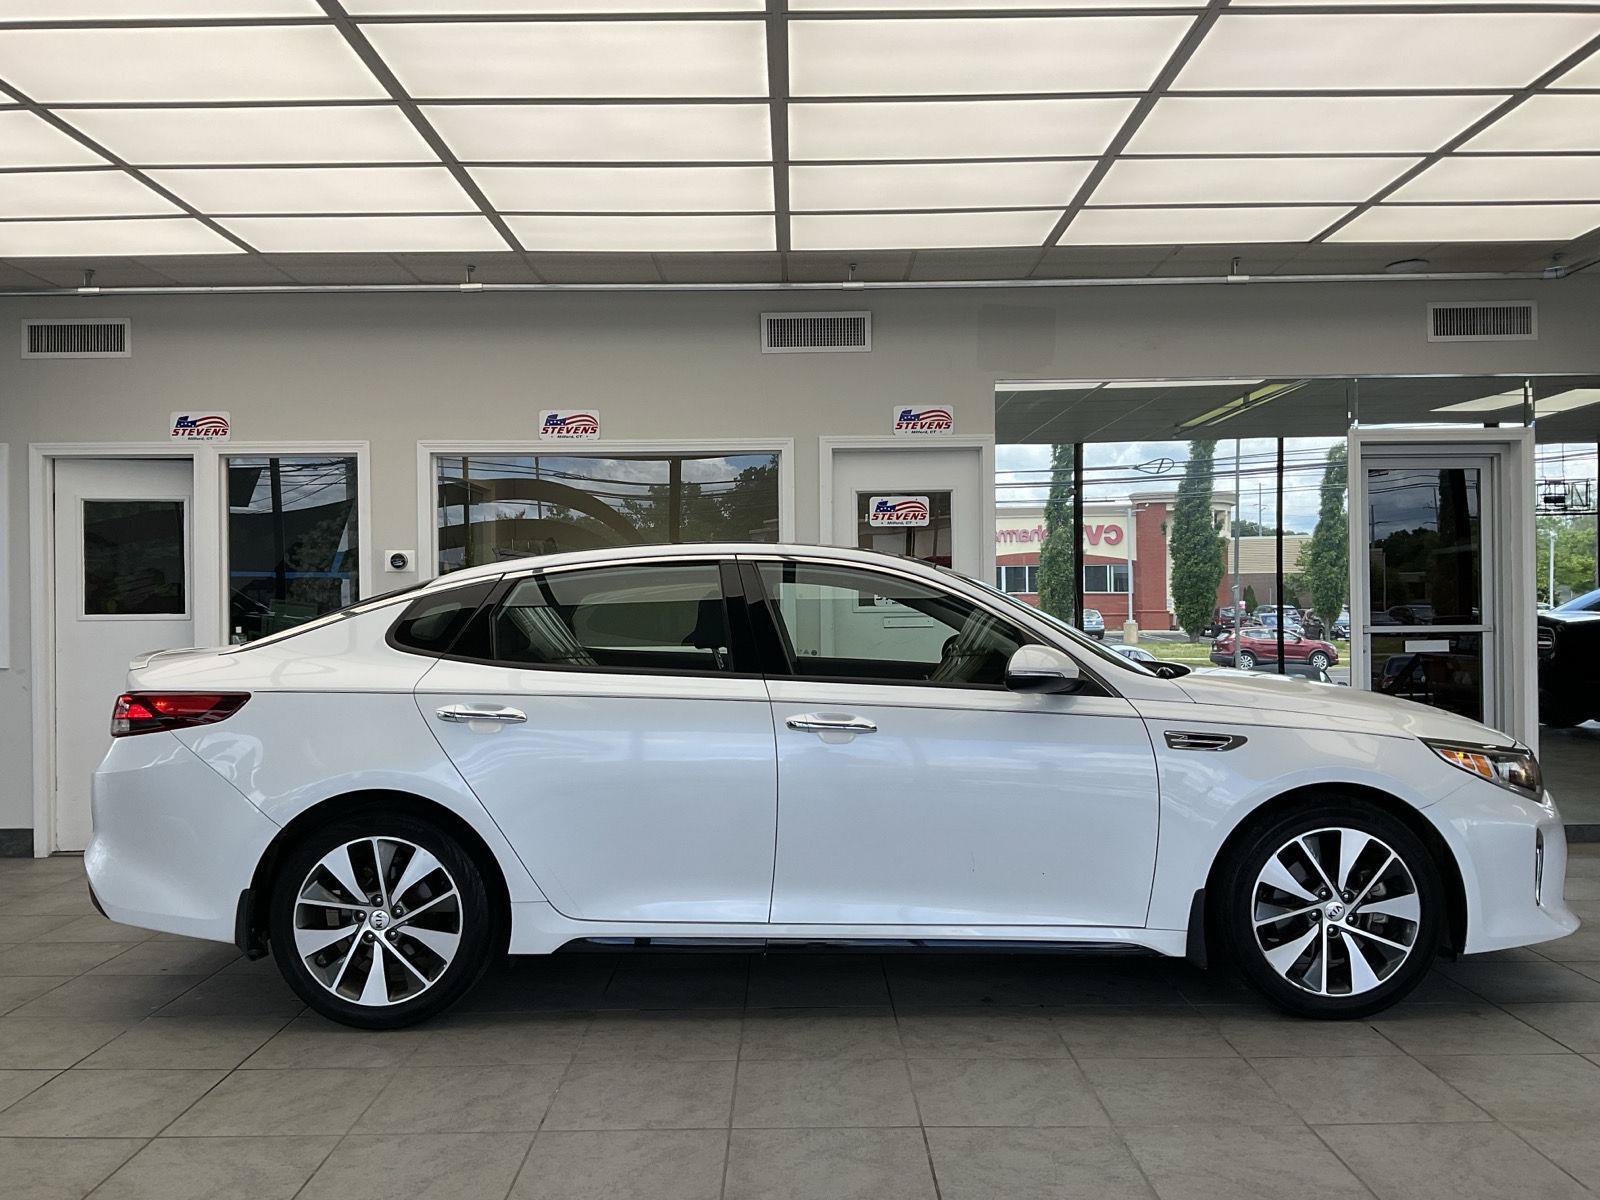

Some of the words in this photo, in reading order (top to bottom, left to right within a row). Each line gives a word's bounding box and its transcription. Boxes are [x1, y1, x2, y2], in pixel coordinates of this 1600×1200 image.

[895, 421, 952, 430] STEVENS
[171, 428, 229, 437] STEVENS
[541, 426, 598, 435] STEVENS
[871, 512, 928, 521] STEVENS
